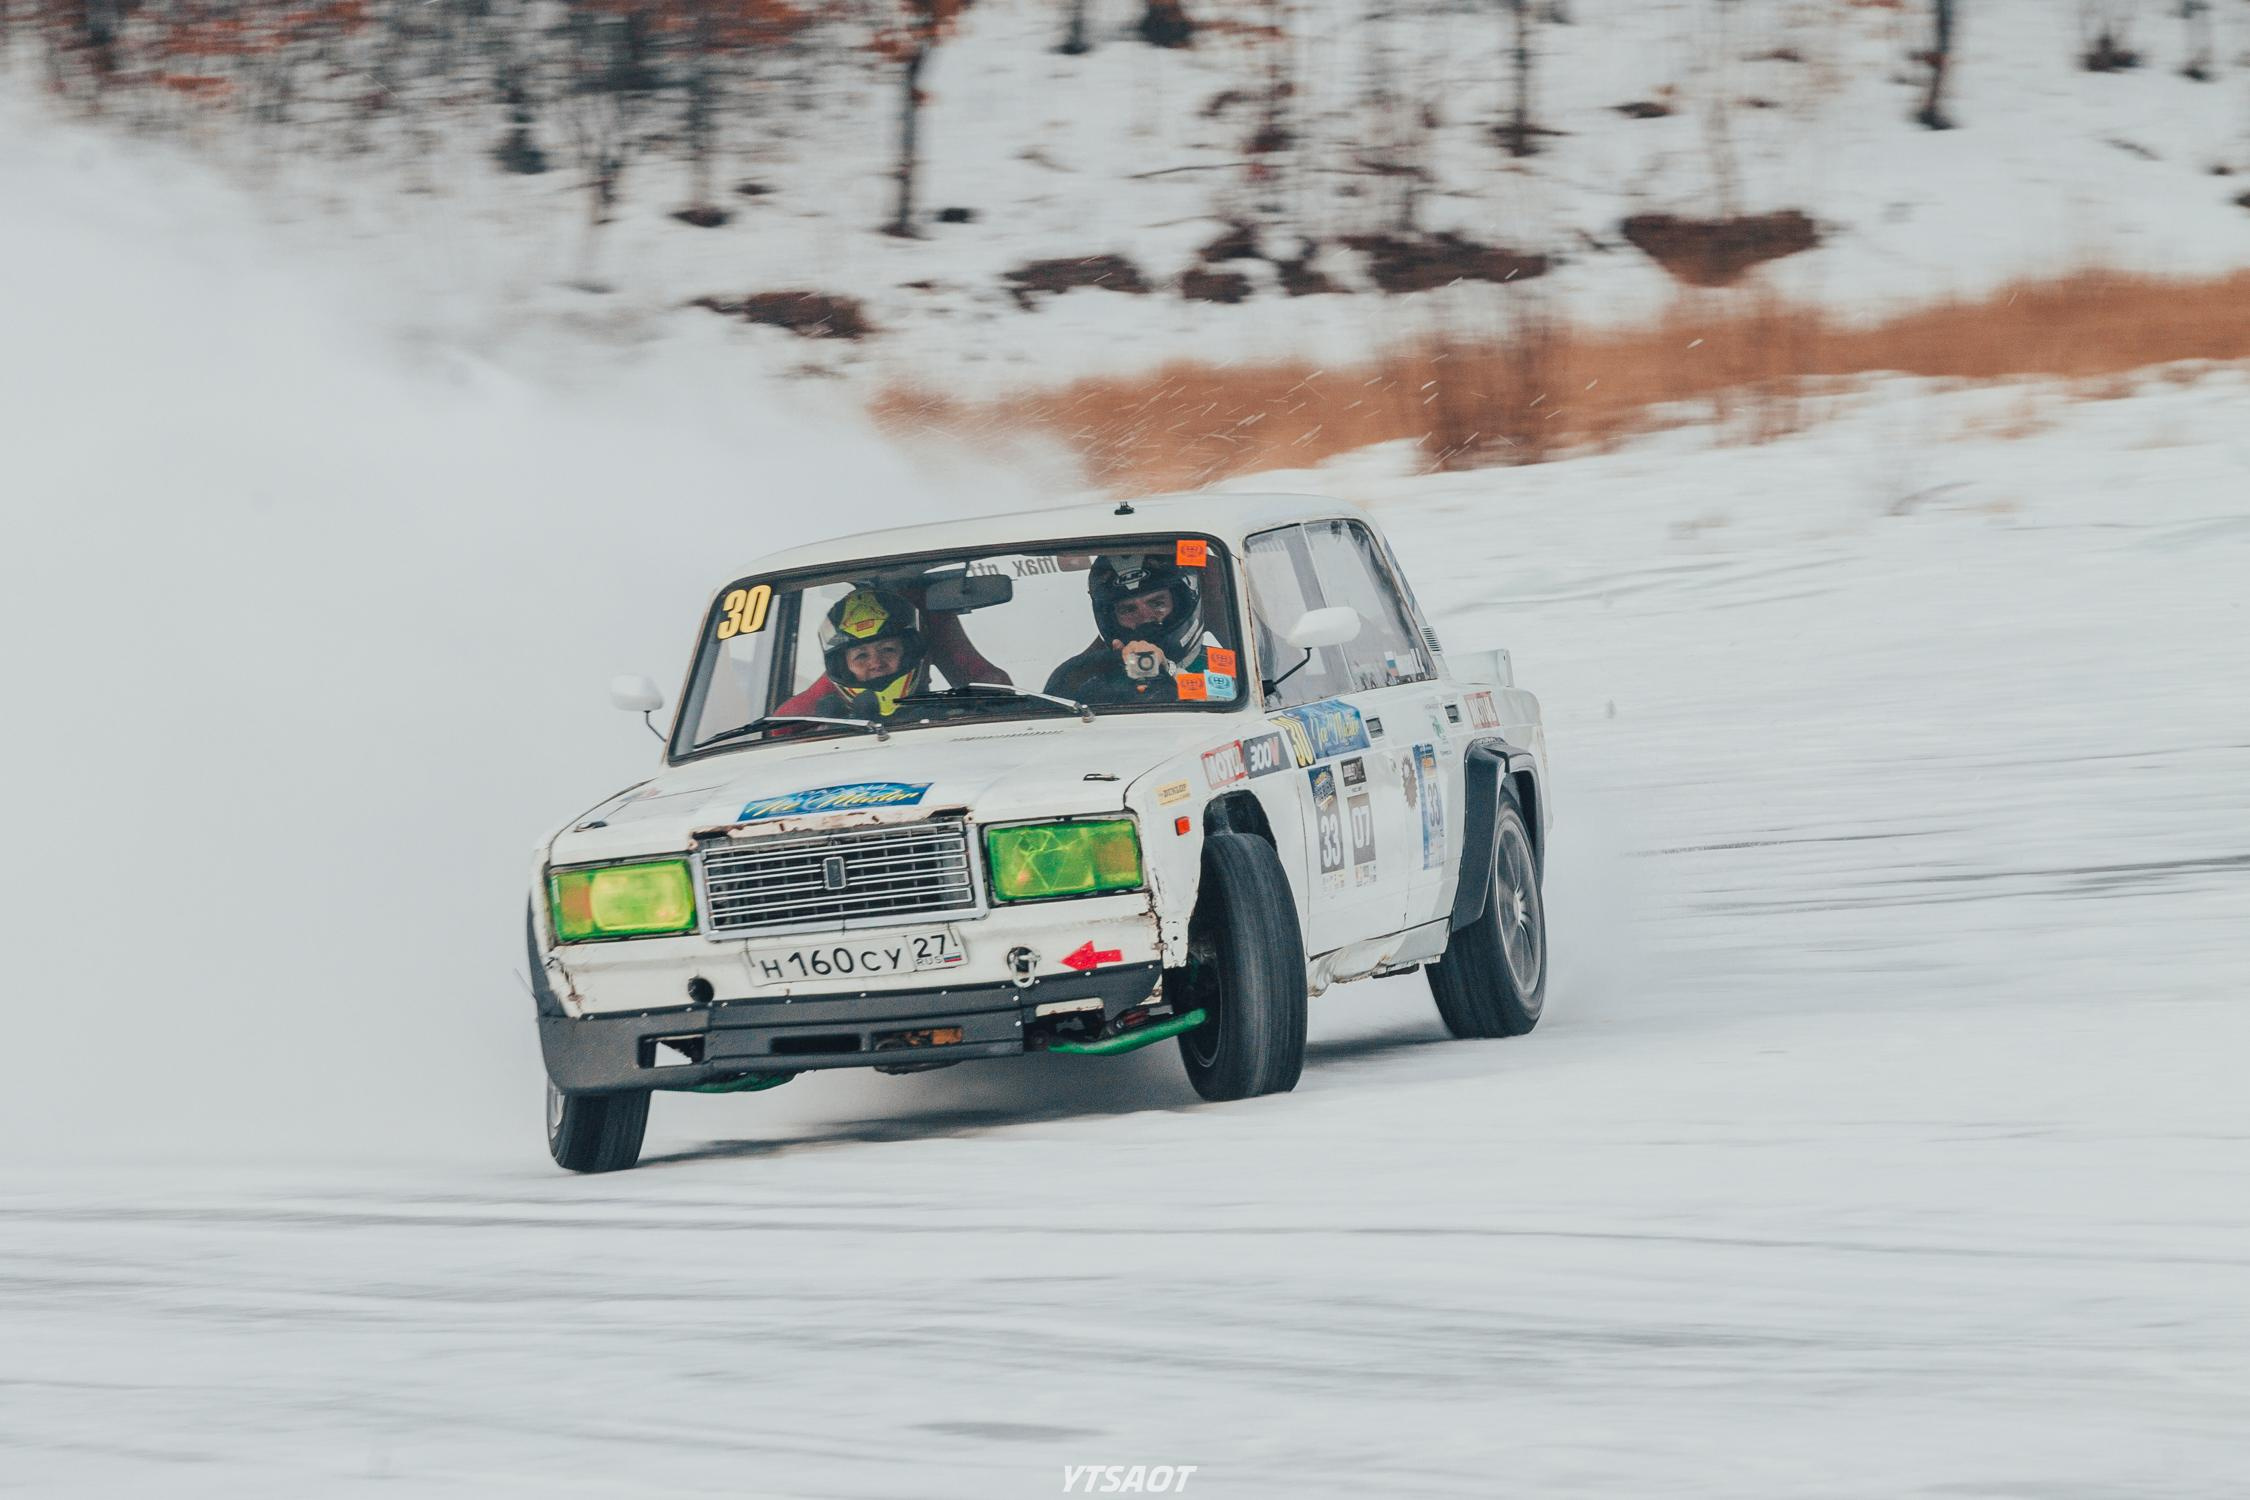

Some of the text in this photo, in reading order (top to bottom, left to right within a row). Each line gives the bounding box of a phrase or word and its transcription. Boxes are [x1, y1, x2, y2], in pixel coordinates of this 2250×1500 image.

[717, 584, 772, 640] 30
[1203, 736, 1280, 786] MOTUL 300V
[1267, 715, 1314, 767] 30
[1351, 805, 1370, 849] 07
[1428, 782, 1442, 828] 33
[1320, 813, 1342, 868] 33
[913, 934, 946, 959] 27
[916, 955, 943, 966] RUS
